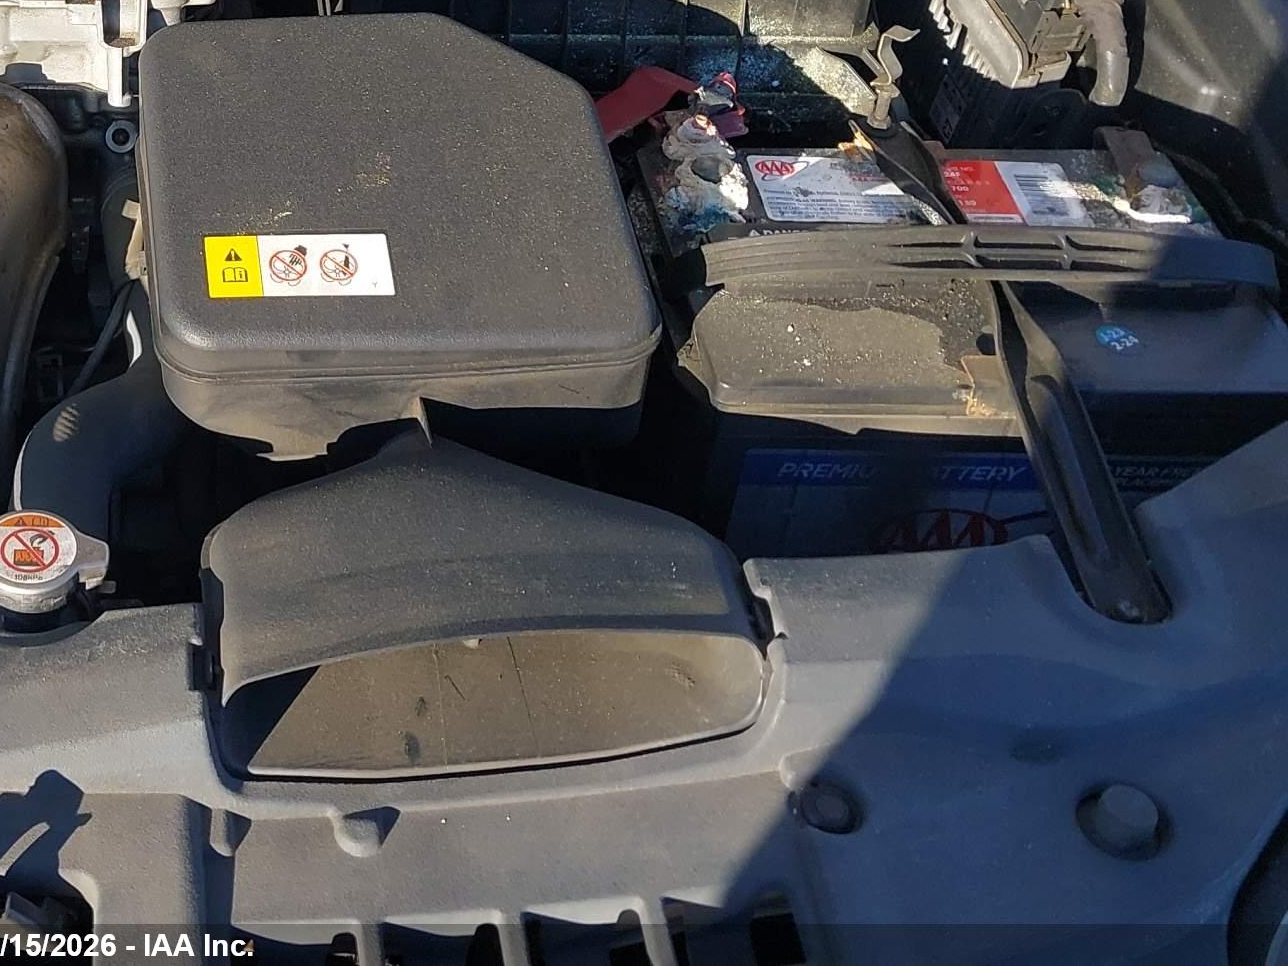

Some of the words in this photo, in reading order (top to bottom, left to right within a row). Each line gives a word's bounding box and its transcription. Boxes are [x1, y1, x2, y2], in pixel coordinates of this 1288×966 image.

[757, 161, 793, 175] AAA
[777, 462, 884, 480] PREMIU
[930, 464, 1028, 481] TTERY
